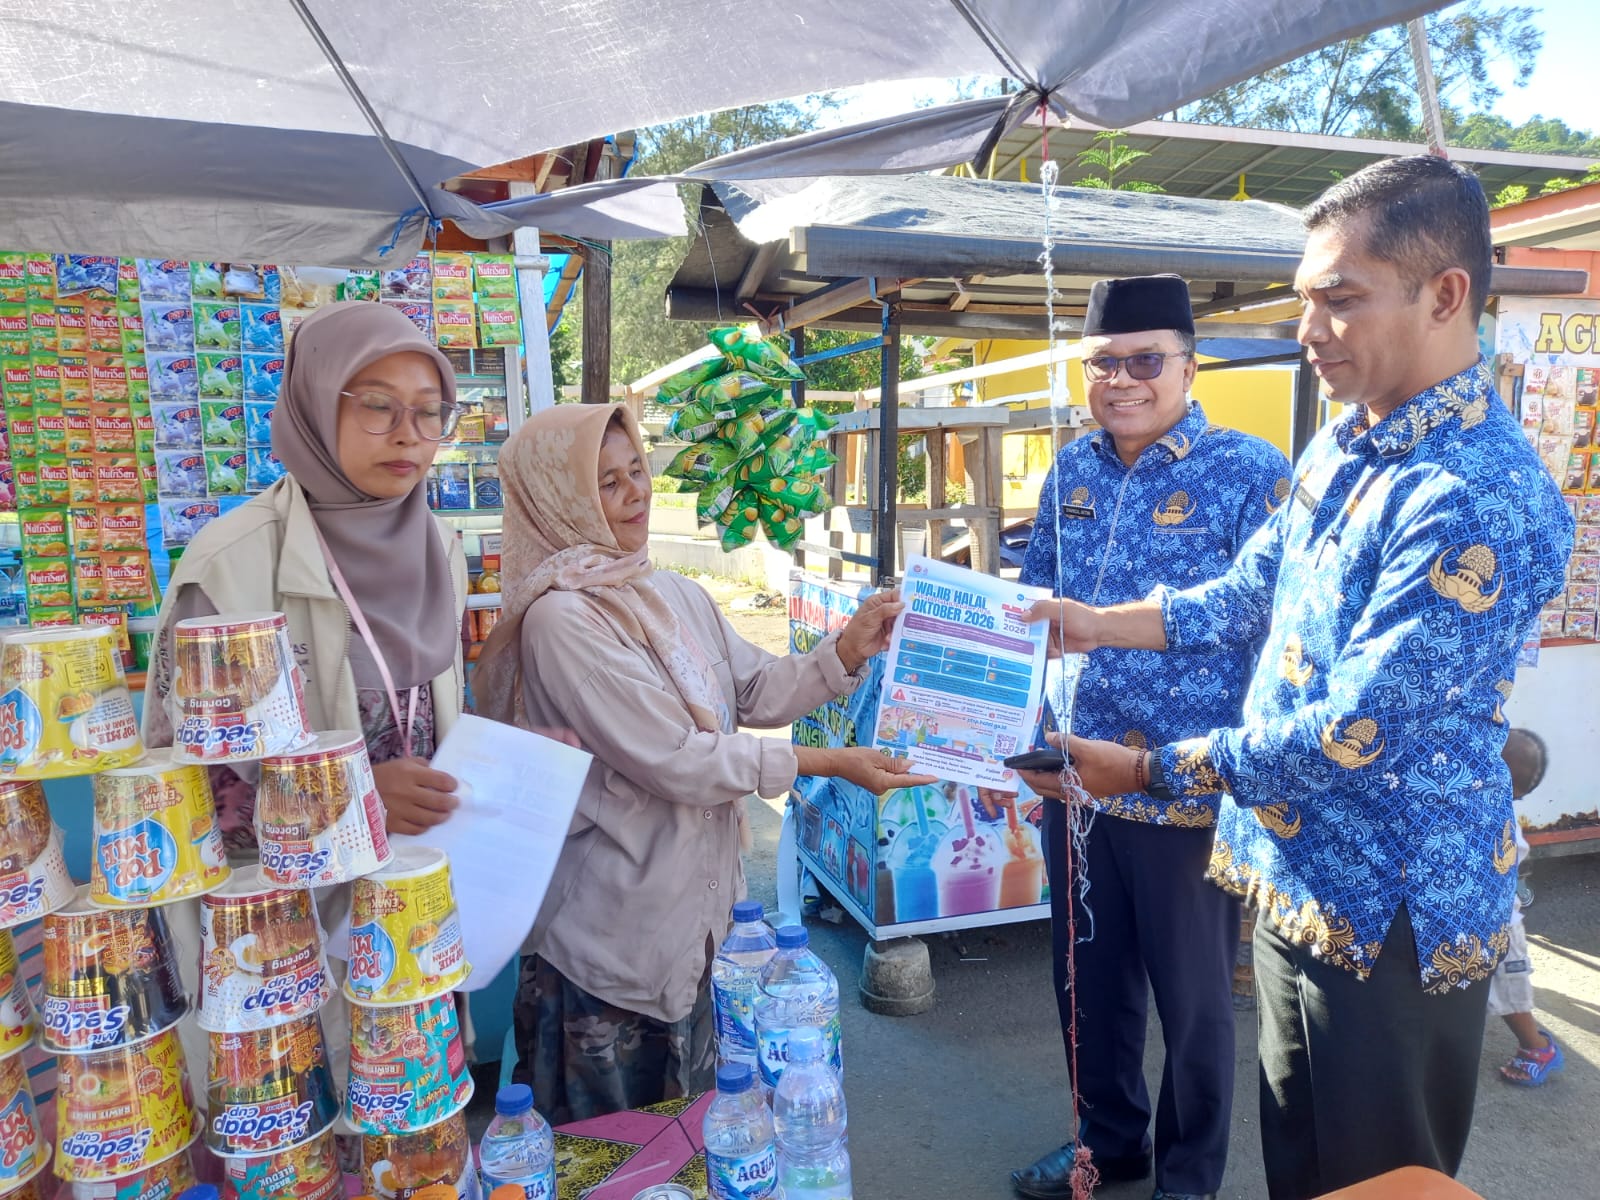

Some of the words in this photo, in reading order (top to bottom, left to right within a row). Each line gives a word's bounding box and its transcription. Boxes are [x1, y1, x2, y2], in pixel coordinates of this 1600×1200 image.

[1535, 313, 1600, 355] AG
[25, 522, 63, 534] NutriSari
[103, 517, 139, 529] NutriSari
[107, 567, 143, 578] NutriSari
[916, 580, 951, 603] WAJIB
[954, 590, 988, 610] HALAL
[912, 598, 962, 622] OKTOBER
[964, 610, 995, 630] 2026
[1003, 623, 1026, 635] 2026
[190, 698, 231, 708] Goreng
[187, 717, 210, 728] Cup
[176, 721, 265, 748] Sedaap
[231, 744, 254, 753] Mie
[266, 825, 299, 836] Goreng
[102, 832, 149, 869] MIE
[116, 848, 163, 887] POP
[272, 949, 310, 970] Goreng
[268, 974, 296, 989] Cup
[244, 970, 326, 1010] Sedaap
[92, 1032, 117, 1043] Mie
[354, 1081, 370, 1093] Cup
[230, 1106, 260, 1118] Cup
[214, 1101, 314, 1139] Sedaap
[75, 1132, 100, 1143] Cup
[280, 1128, 305, 1142] Mie
[62, 1129, 152, 1161] Sedaap
[121, 1151, 144, 1164] Mie
[737, 1152, 775, 1183] AQUA
